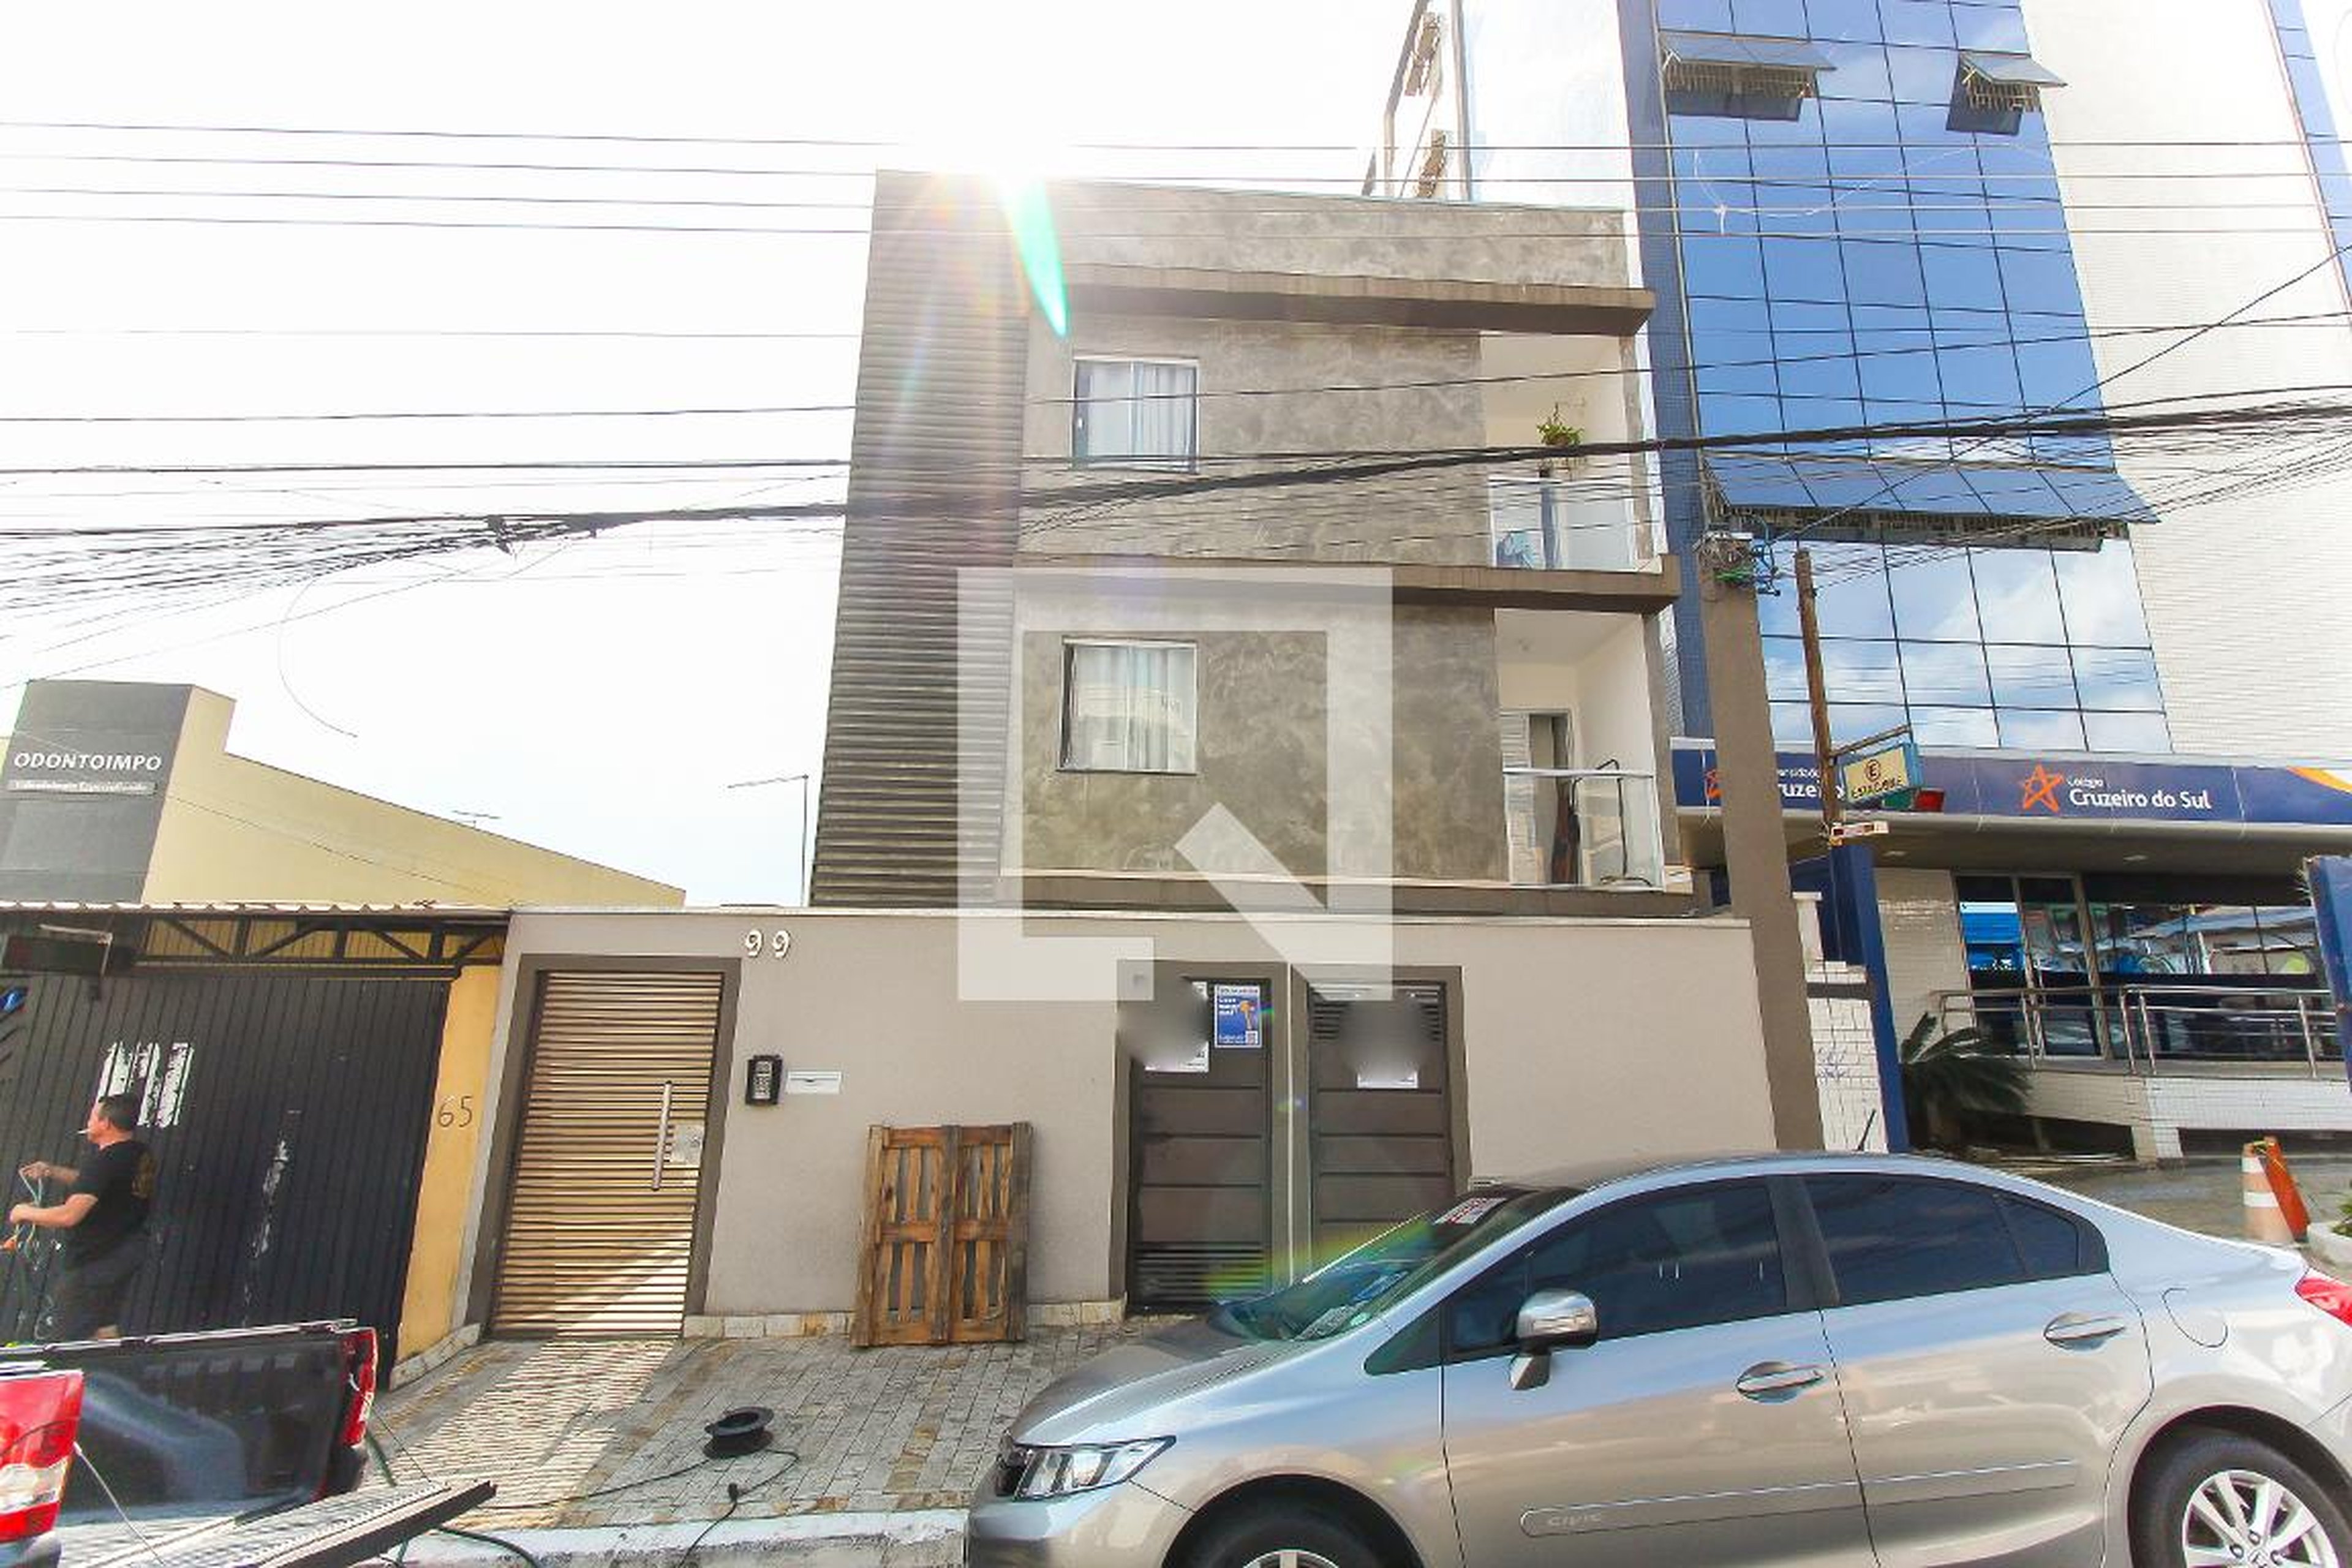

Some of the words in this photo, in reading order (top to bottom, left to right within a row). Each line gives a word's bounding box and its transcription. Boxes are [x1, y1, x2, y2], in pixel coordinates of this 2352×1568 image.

[14, 752, 162, 771] ODONTOIMPO
[2069, 788, 2147, 807] Cruzeiro
[2152, 790, 2176, 808] do
[2179, 790, 2212, 809] Sul
[745, 930, 790, 958] 99
[438, 1095, 473, 1127] 65
[1547, 1512, 1602, 1528] CIVIC
